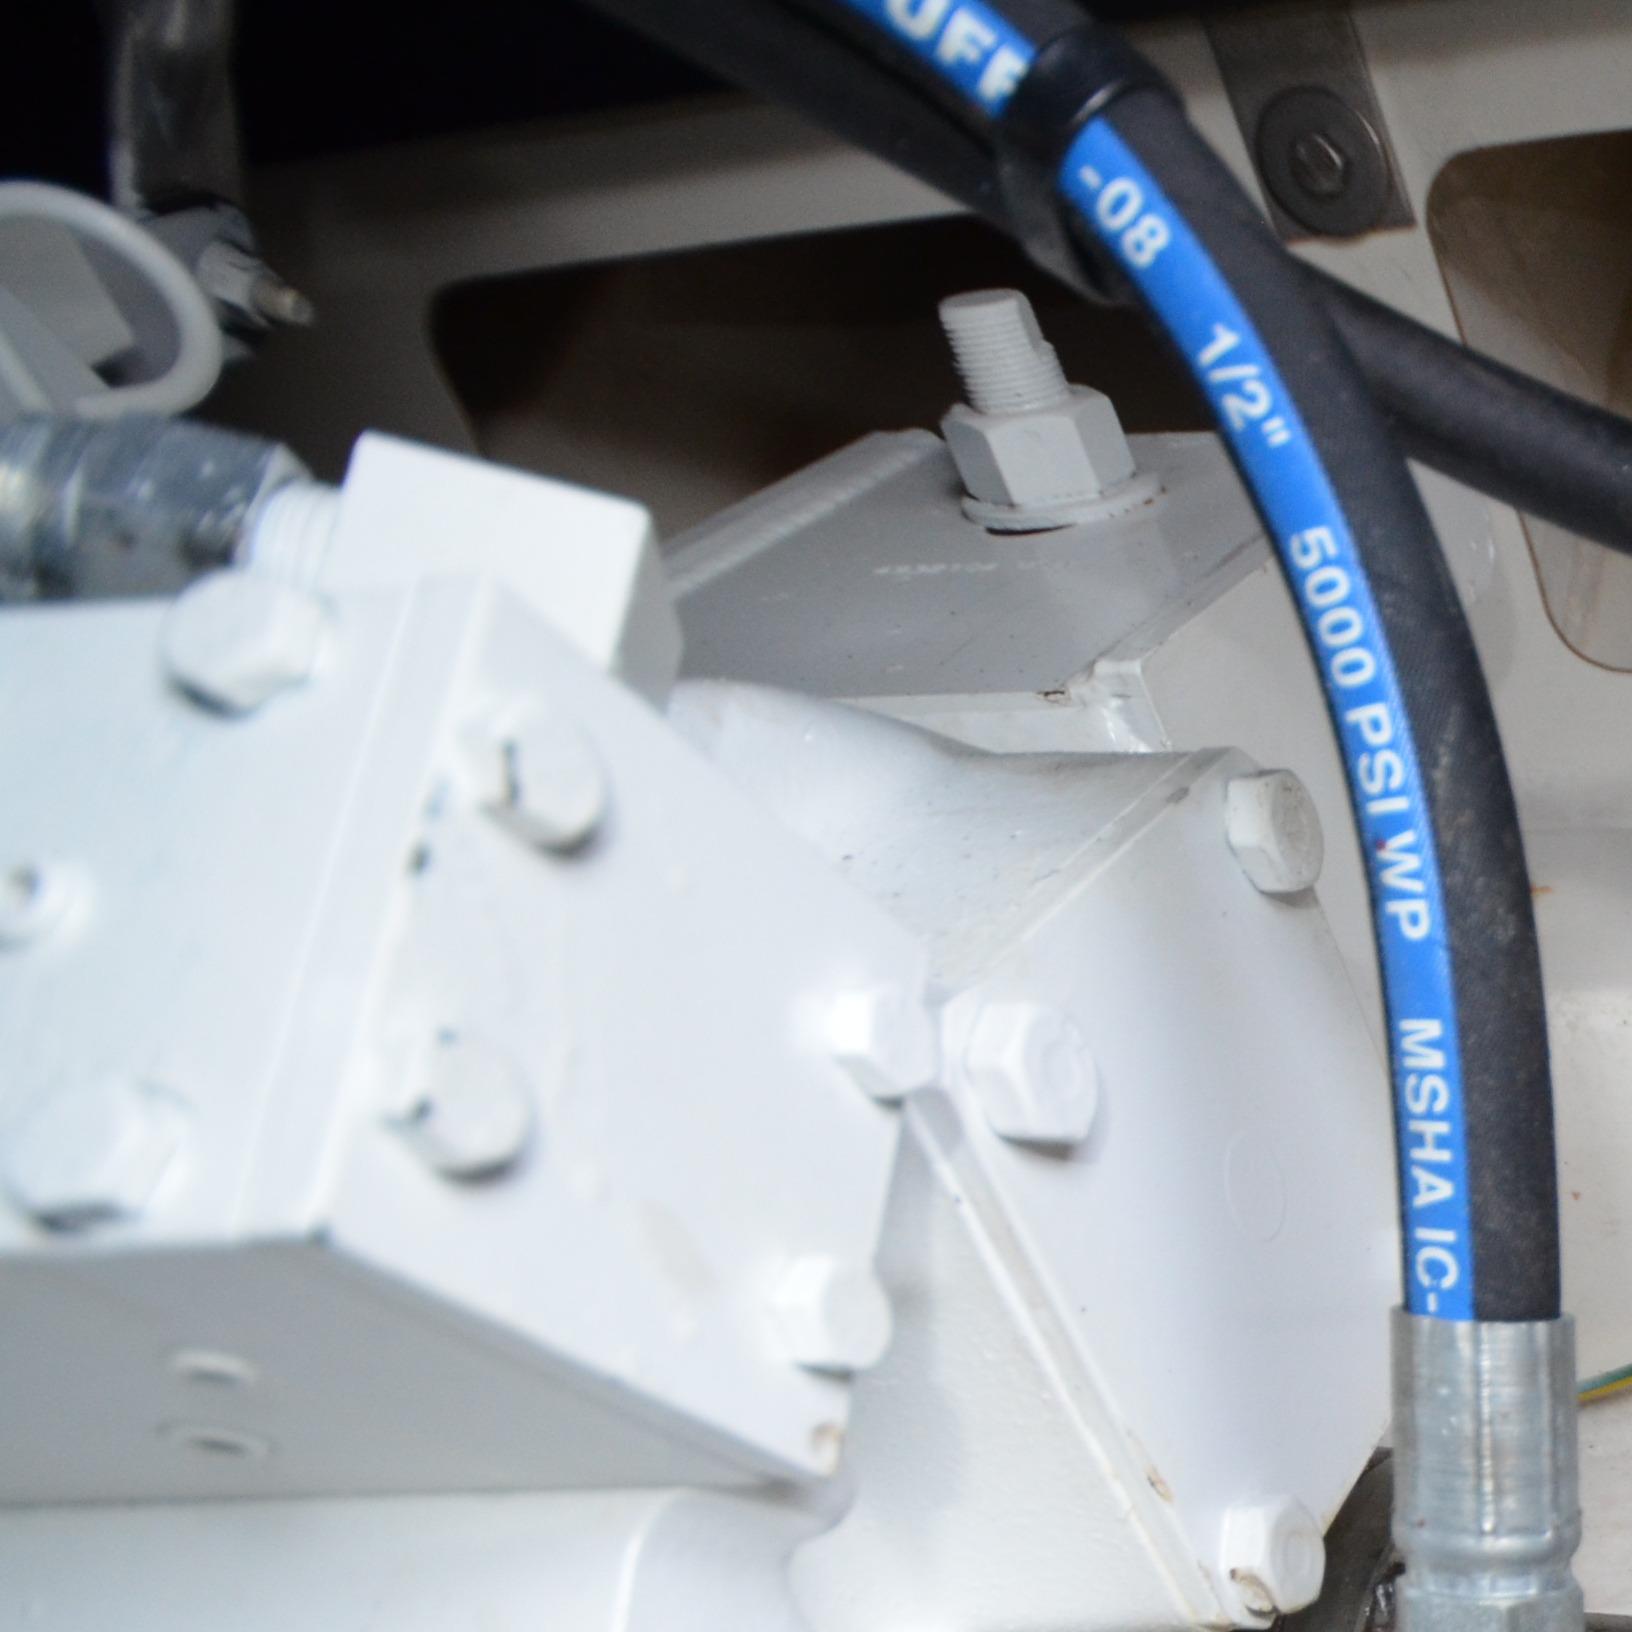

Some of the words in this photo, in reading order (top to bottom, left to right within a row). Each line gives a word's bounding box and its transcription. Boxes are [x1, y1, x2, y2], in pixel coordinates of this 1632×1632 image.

[1199, 324, 1292, 446] 1/2"
[1291, 525, 1378, 688] 5000
[1346, 702, 1412, 816] PSI
[1376, 828, 1432, 941] WP
[1399, 1018, 1456, 1208] MSHA
[1414, 1226, 1460, 1313] IC-
